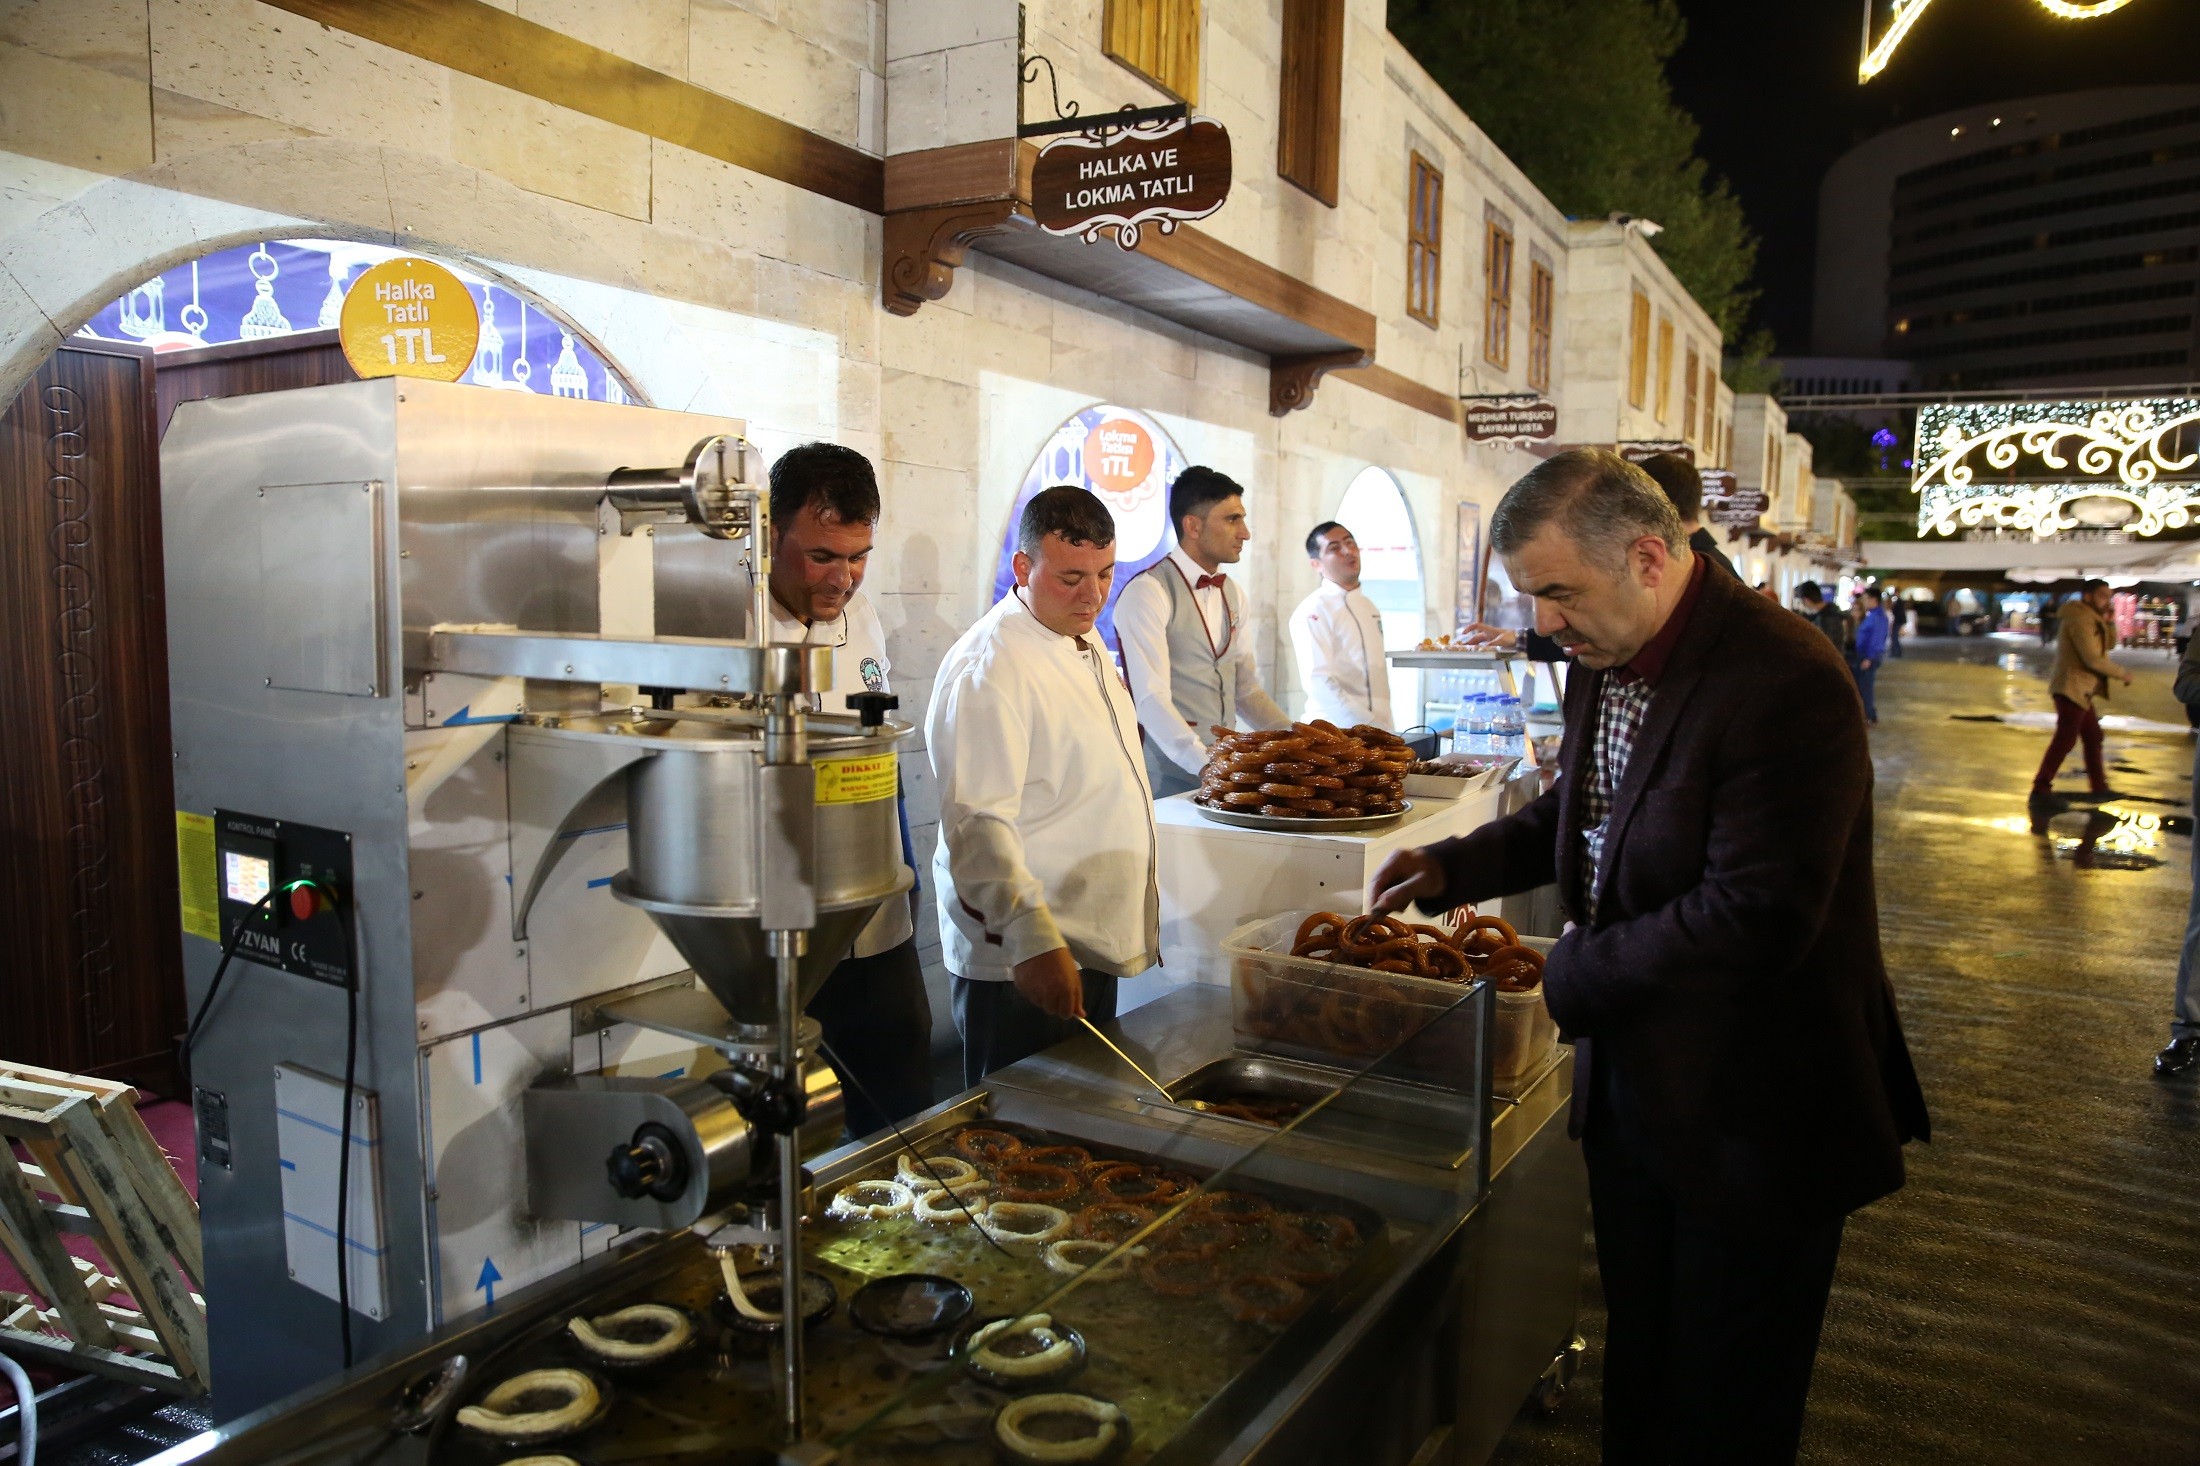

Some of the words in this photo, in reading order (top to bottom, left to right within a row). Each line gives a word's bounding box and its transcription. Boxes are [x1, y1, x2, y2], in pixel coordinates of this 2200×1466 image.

[1079, 153, 1147, 180] HALKA
[1151, 148, 1178, 168] VE
[1065, 186, 1136, 210] LOKMA
[1140, 174, 1194, 198] TATLI
[375, 279, 435, 301] Halka
[383, 301, 429, 323] Tatlı
[1477, 423, 1517, 434] BAYRAM
[1518, 422, 1544, 433] USTA
[227, 822, 255, 835] KONTROL
[256, 825, 277, 839] PANEL
